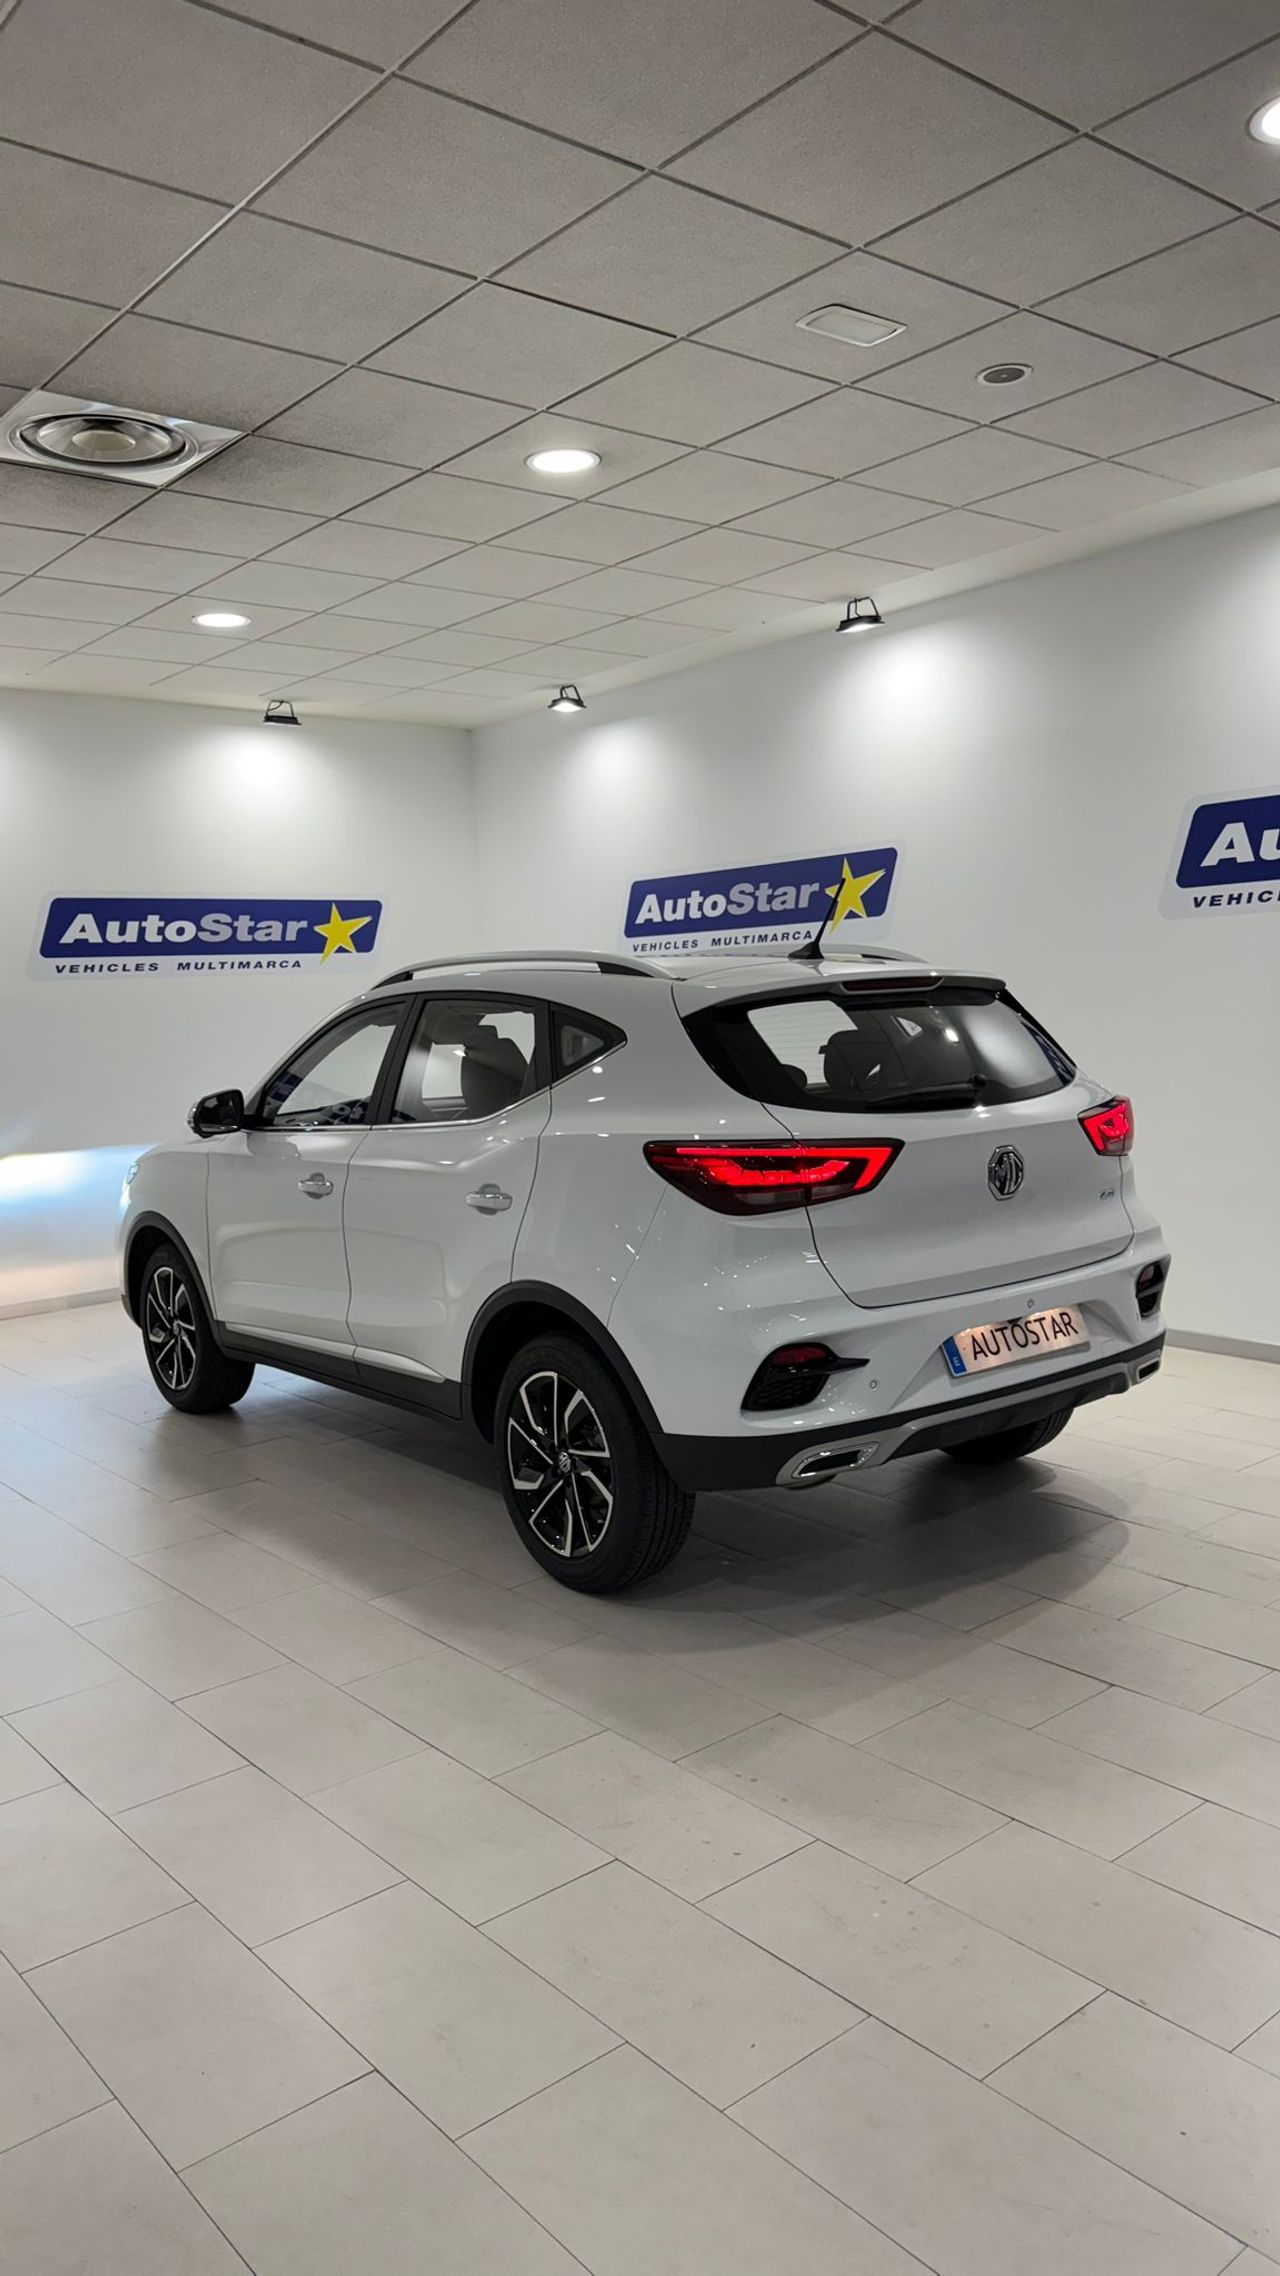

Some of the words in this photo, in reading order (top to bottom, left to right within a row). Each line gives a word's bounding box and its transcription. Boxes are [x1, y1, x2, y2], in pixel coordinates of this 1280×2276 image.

[635, 882, 819, 924] AutoStar
[1193, 890, 1280, 908] VEHIC
[59, 913, 308, 943] AutoStar
[633, 939, 698, 952] VEHICLES
[711, 930, 813, 947] MULTIMARCA
[55, 962, 159, 974] VEHICLES
[177, 960, 302, 971] MULTIMARCA
[971, 1312, 1079, 1361] AUTOSTAR
